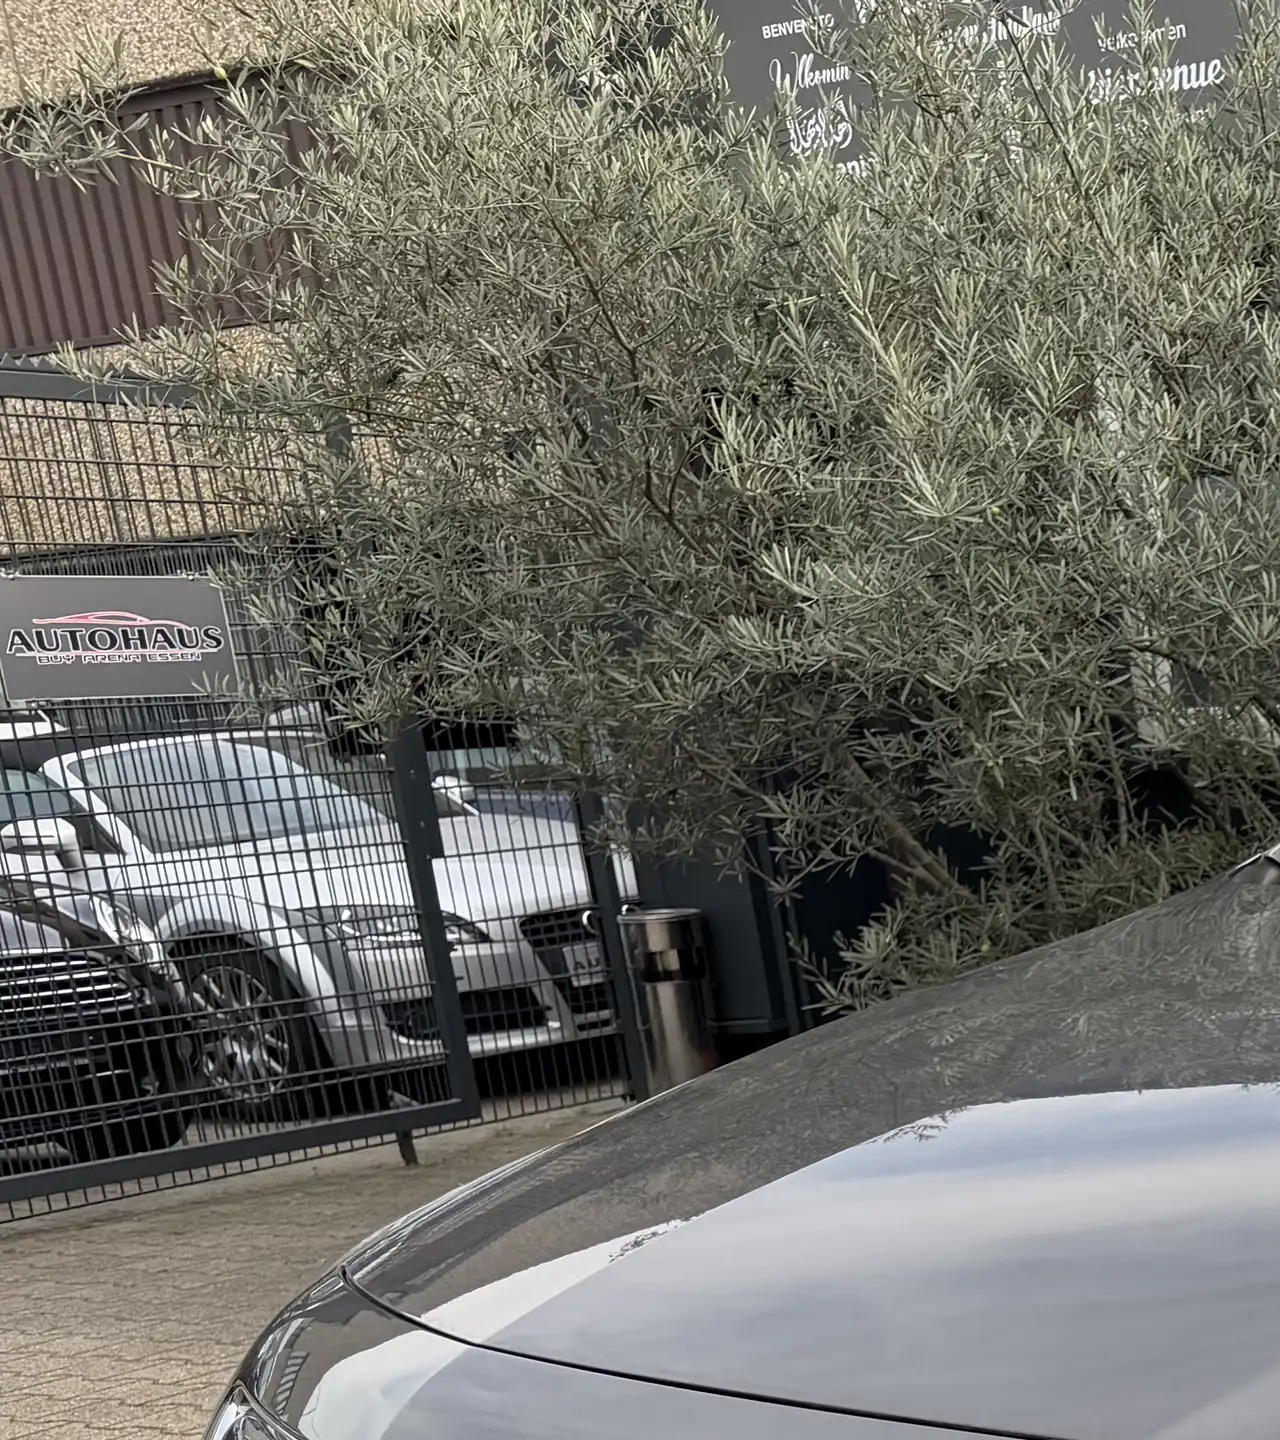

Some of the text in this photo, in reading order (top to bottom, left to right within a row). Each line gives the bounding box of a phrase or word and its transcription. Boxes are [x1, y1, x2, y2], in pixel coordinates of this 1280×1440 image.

[6, 626, 225, 654] AUTOHAUS
[37, 652, 202, 665] BUY ARENA ESSEN
